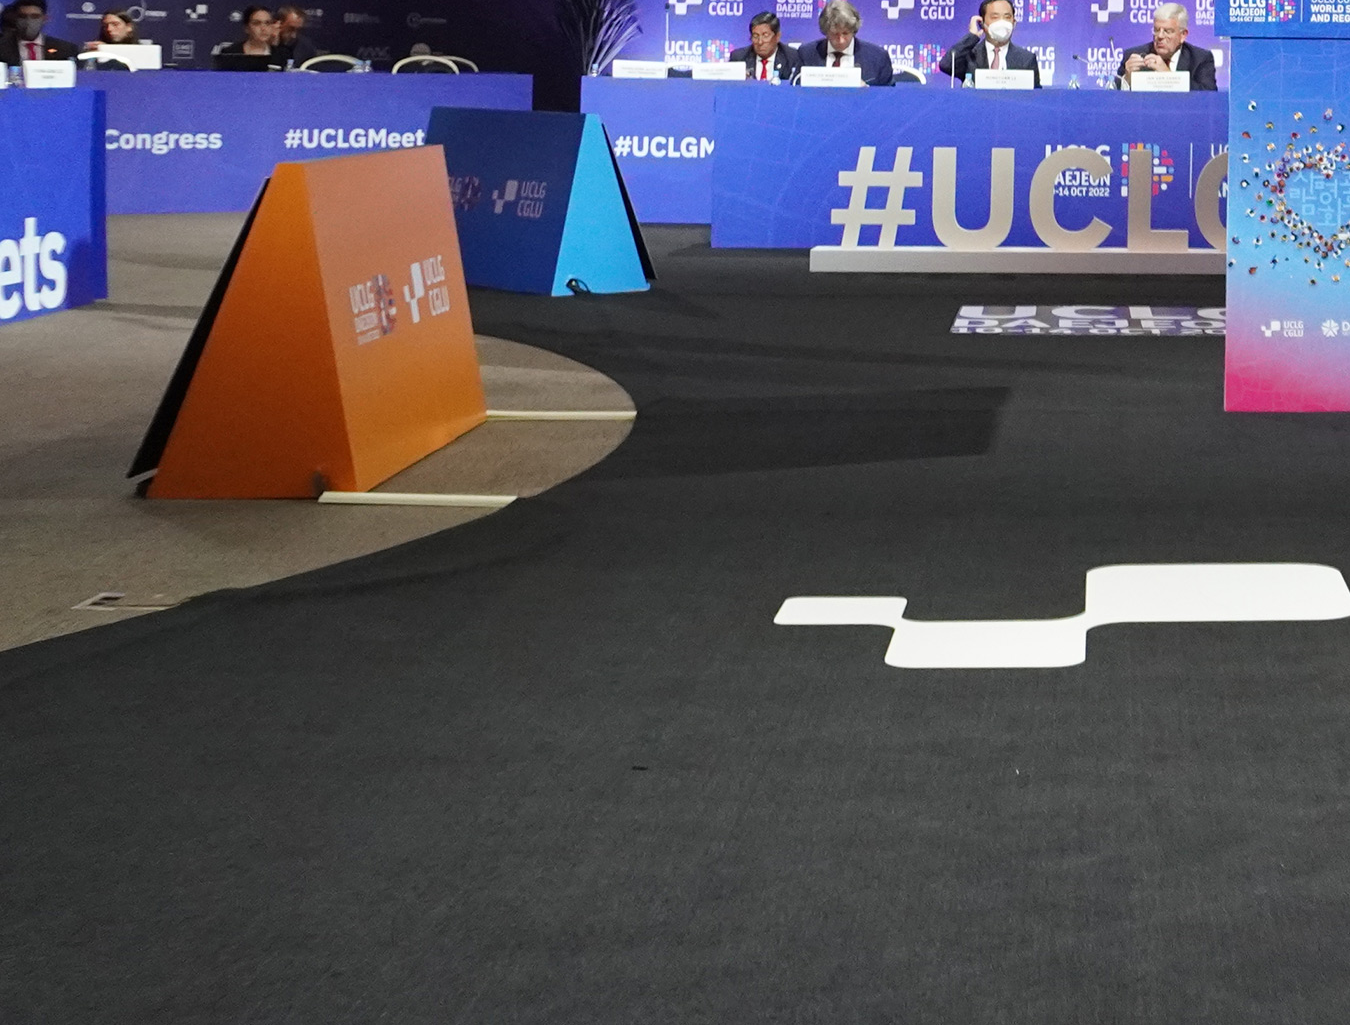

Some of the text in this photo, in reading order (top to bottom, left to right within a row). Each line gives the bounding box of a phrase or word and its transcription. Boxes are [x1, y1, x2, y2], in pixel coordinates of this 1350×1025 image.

[709, 2, 743, 16] CGLU
[776, 3, 813, 13] DAEJEON
[921, 6, 955, 20] CGLU
[1229, 7, 1266, 17] DAEJEON
[1310, 4, 1344, 14] WORLD
[1130, 9, 1154, 23] CGL
[1310, 13, 1331, 23] AND
[665, 40, 702, 55] UCLG
[1088, 48, 1124, 62] UCLG
[105, 129, 223, 154] Congress
[1054, 171, 1110, 186] AEJEON
[520, 180, 548, 198] UCLG
[1071, 187, 1087, 197] OCT
[1088, 187, 1110, 198] 2022
[517, 199, 544, 219] CGLU
[1283, 321, 1304, 329] UCLG
[1283, 329, 1304, 337] CGLU
